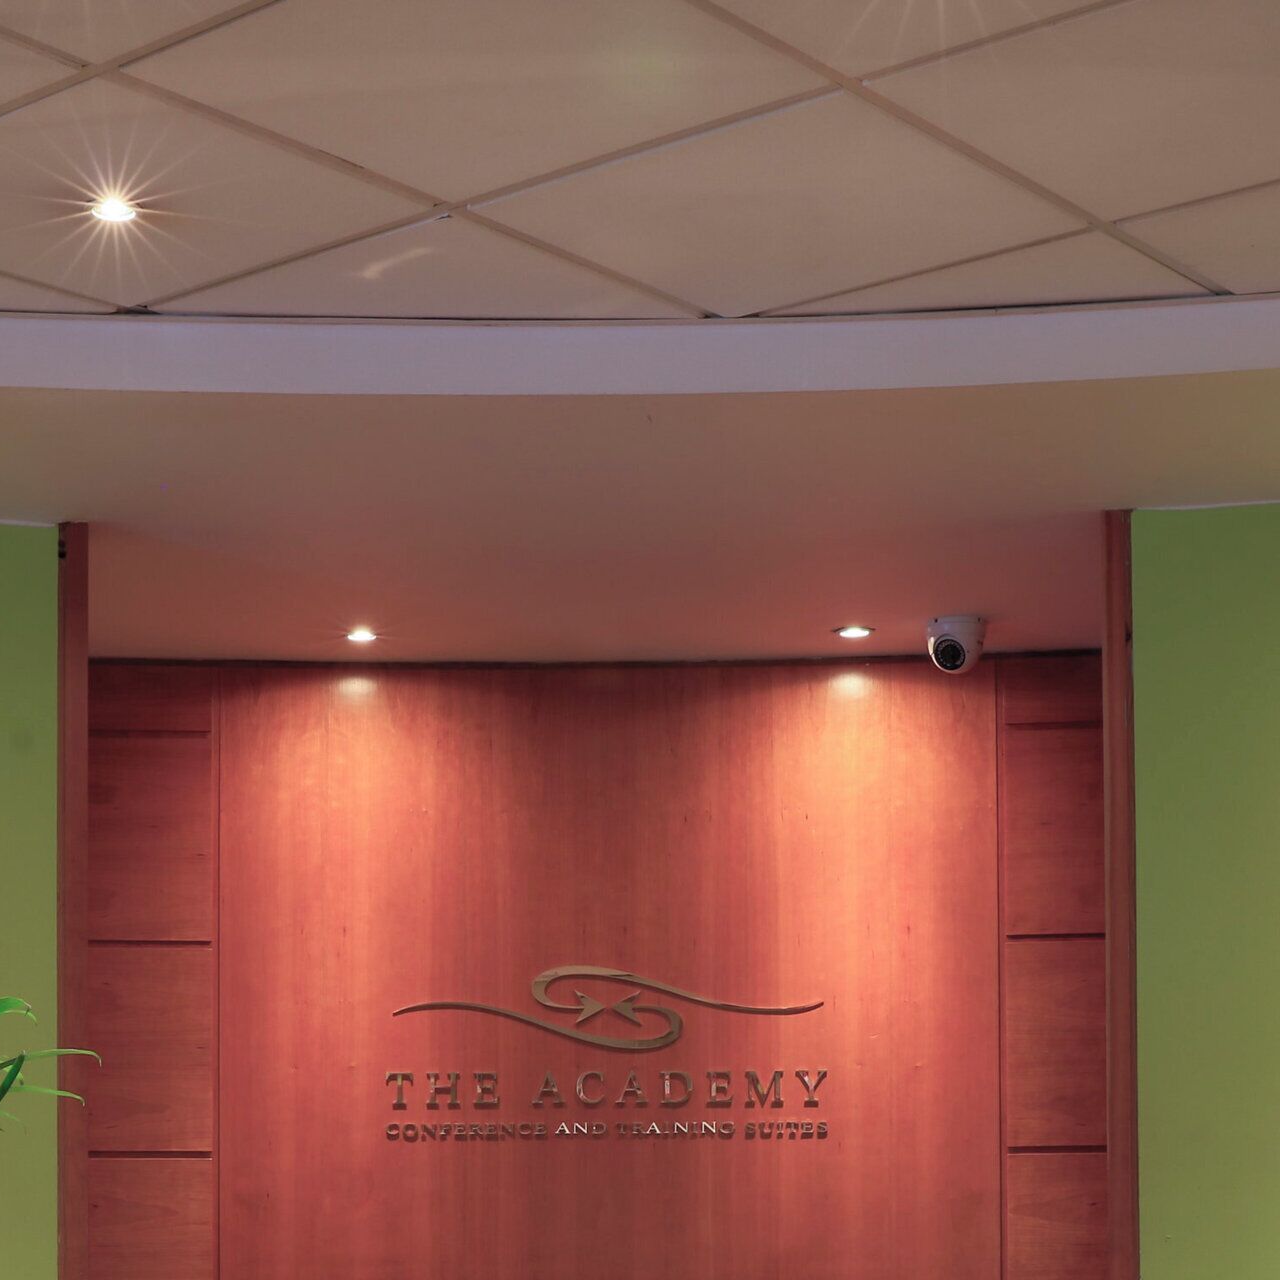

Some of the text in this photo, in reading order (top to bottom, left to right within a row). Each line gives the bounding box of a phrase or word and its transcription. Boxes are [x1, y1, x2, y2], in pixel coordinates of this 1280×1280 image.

[385, 1070, 828, 1109] THE ACADEMY
[385, 1121, 829, 1139] CONFERENCE AND TRAINING SUITES
